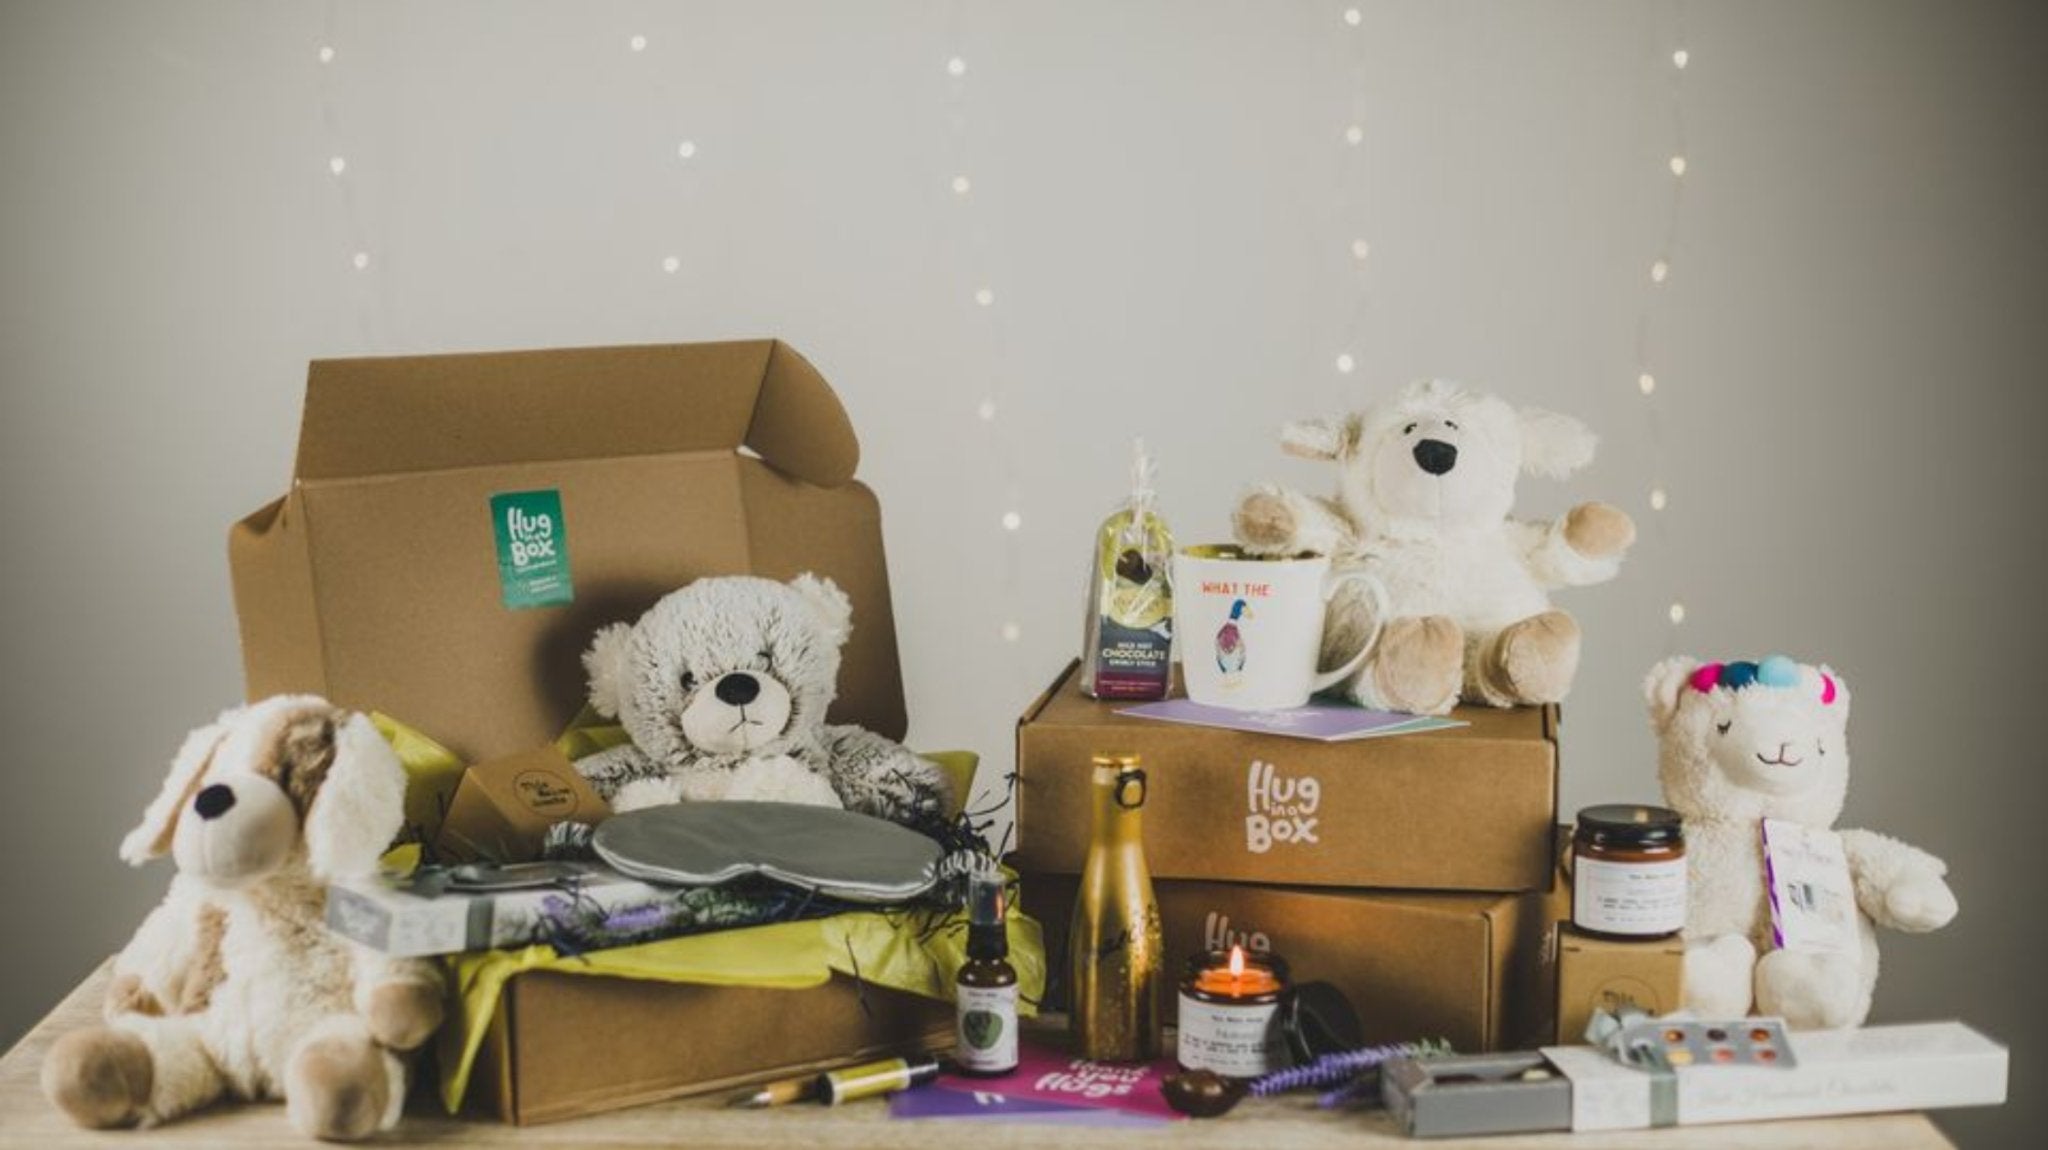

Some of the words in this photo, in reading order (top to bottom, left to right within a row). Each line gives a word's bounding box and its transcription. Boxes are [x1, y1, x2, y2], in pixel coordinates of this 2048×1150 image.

[507, 507, 552, 541] Hug
[1202, 582, 1239, 595] WHAT
[1245, 583, 1272, 597] THE
[1102, 648, 1165, 660] CHOCOLATE
[1247, 760, 1321, 815] Hug
[1271, 802, 1285, 816] in
[1245, 814, 1320, 854] Box
